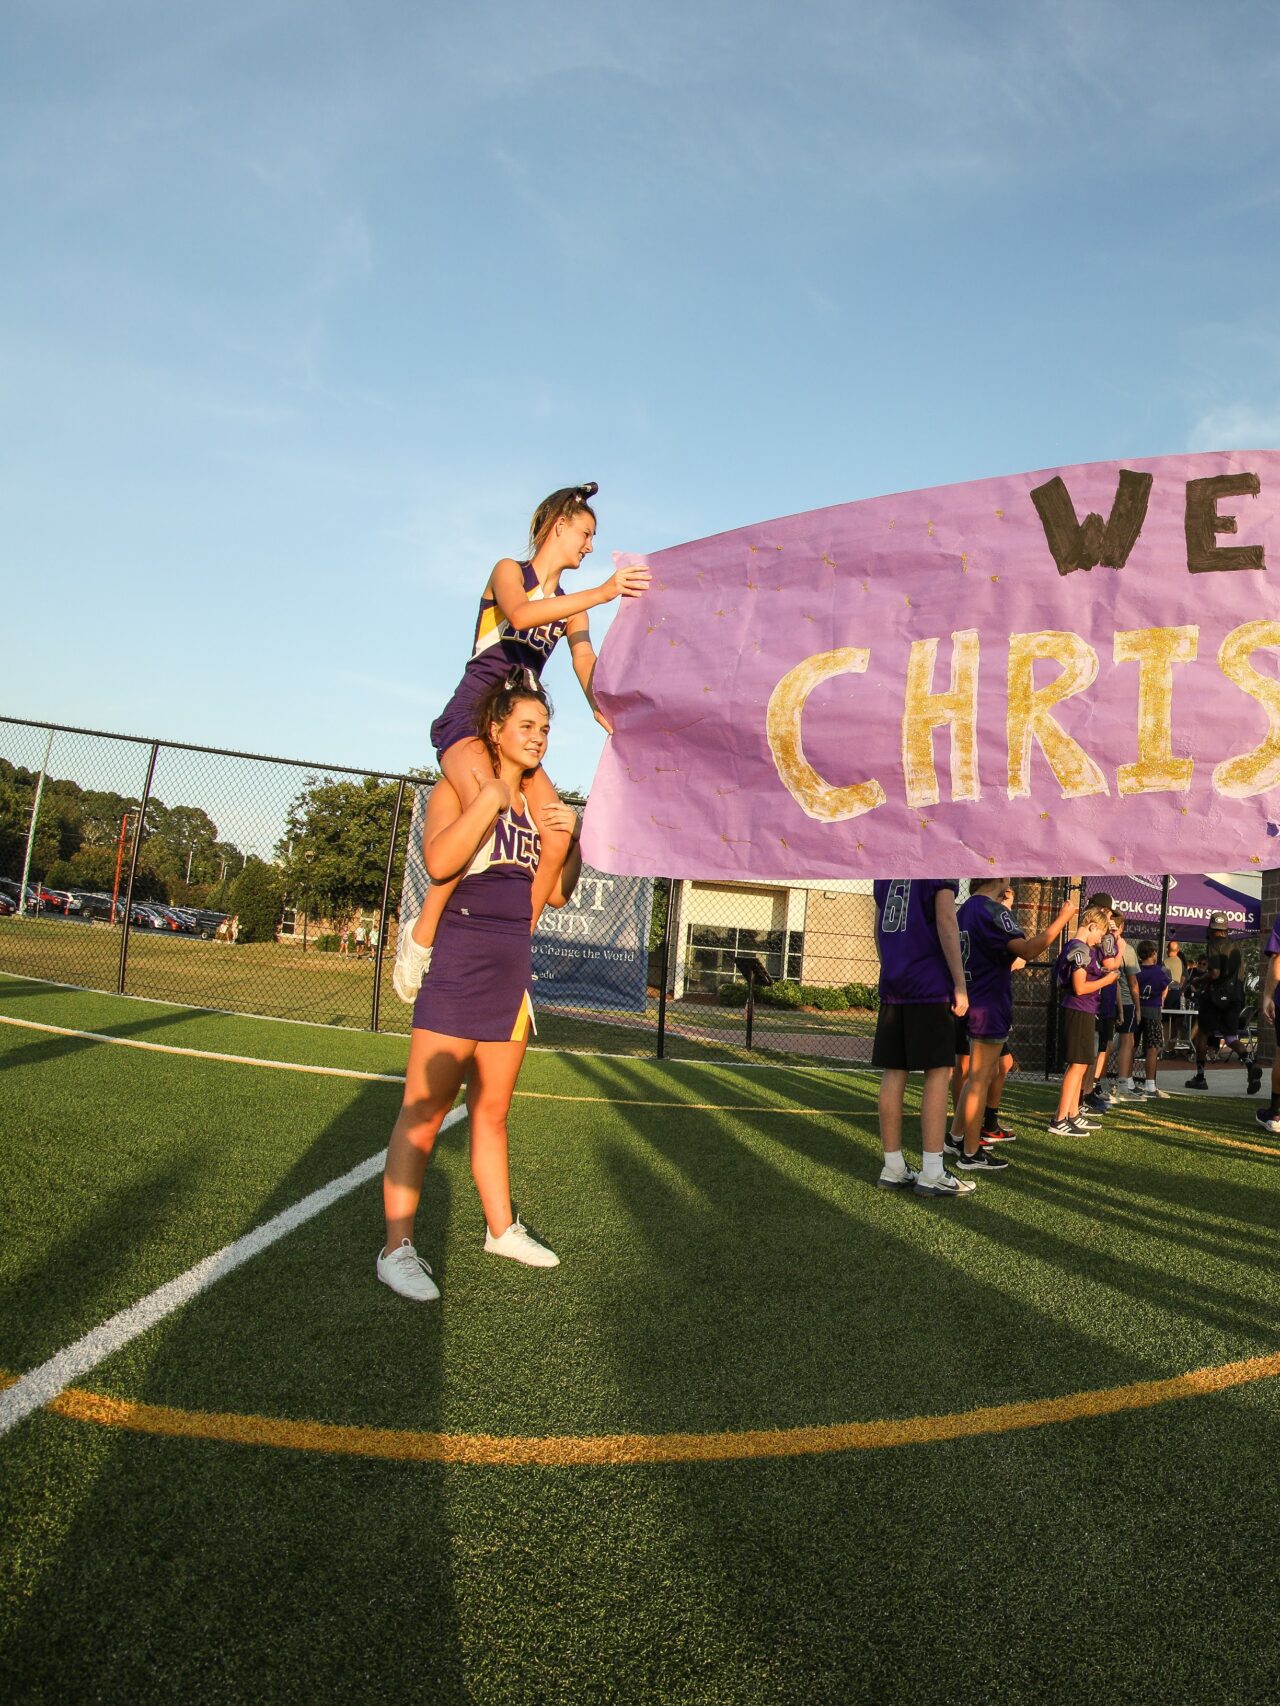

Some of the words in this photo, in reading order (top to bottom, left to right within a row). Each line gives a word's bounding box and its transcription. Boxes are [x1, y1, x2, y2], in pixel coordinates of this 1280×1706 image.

[1029, 468, 1267, 577] WE
[489, 823, 541, 868] NCS
[1205, 908, 1255, 923] SOOLS
[540, 943, 581, 959] Change
[582, 948, 601, 960] the
[603, 949, 635, 962] World
